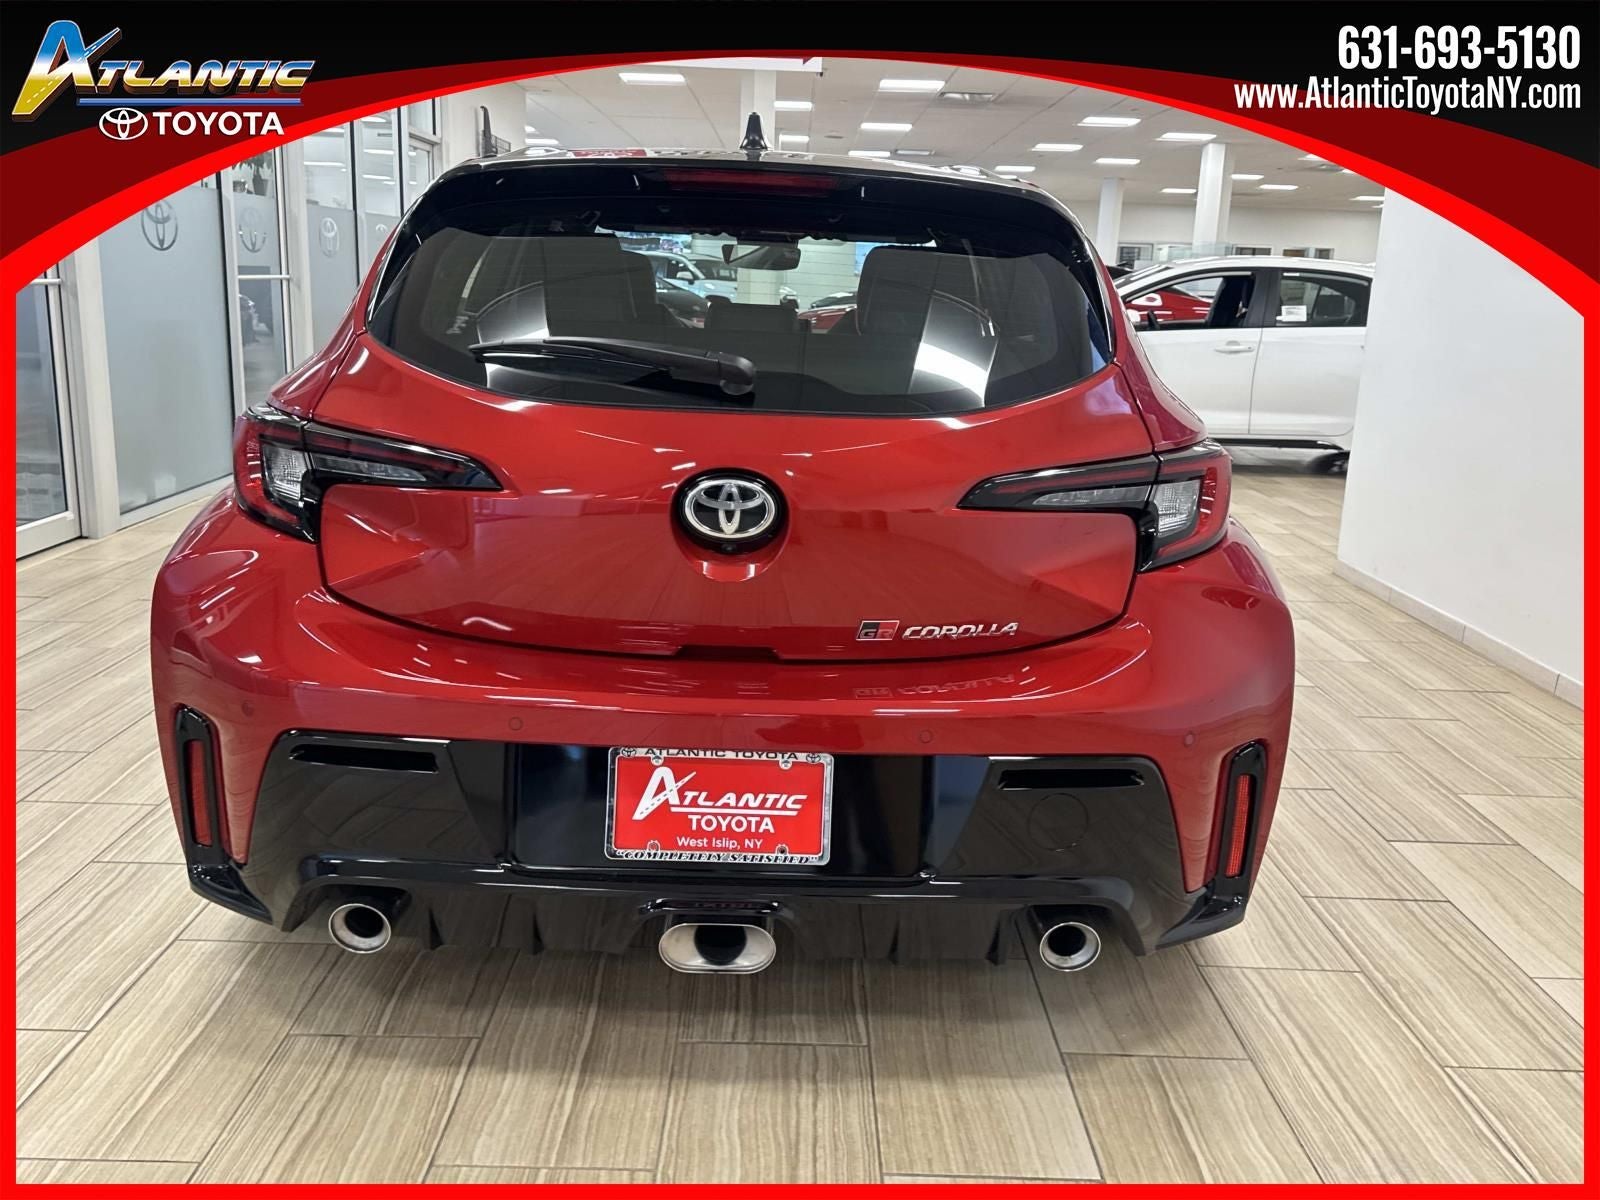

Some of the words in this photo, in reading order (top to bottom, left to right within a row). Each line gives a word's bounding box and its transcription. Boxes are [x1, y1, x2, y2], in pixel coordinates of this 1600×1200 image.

[859, 626, 895, 640] GR
[902, 622, 1019, 640] COROLLA
[645, 748, 726, 758] ATLANTIC
[733, 752, 798, 760] TOYOTA
[632, 766, 808, 820] ATLANTIC
[688, 815, 775, 833] TOYOTA
[677, 836, 708, 848] West
[713, 838, 740, 850] Islip,
[744, 839, 763, 849] NY
